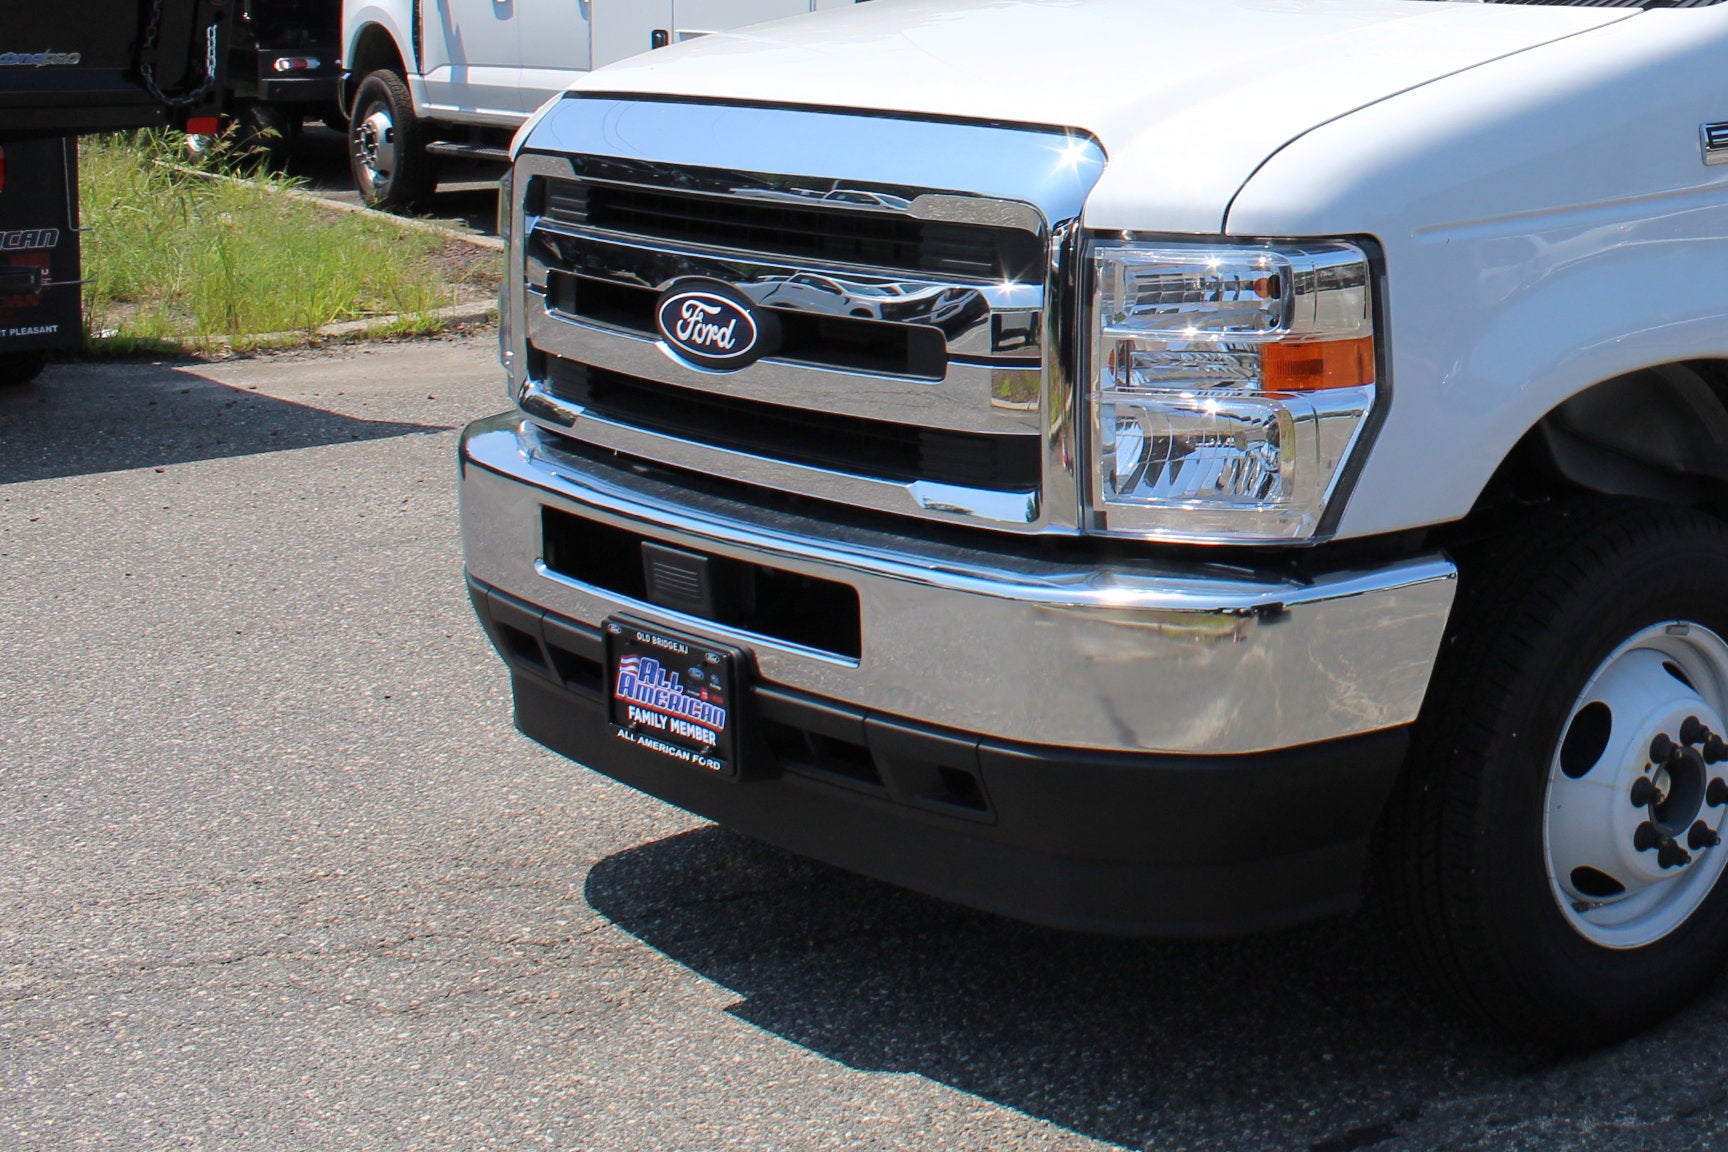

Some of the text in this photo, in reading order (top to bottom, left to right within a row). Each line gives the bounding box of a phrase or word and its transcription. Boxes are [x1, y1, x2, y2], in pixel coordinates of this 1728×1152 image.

[9, 324, 59, 336] PLEASANT
[676, 299, 737, 350] Ford
[636, 631, 650, 644] OLD
[638, 656, 684, 694] ALL
[616, 671, 726, 730] AMERICAN
[628, 705, 717, 747] FAMILY MEMBER
[617, 728, 721, 771] ALL AMERICAN FORD
